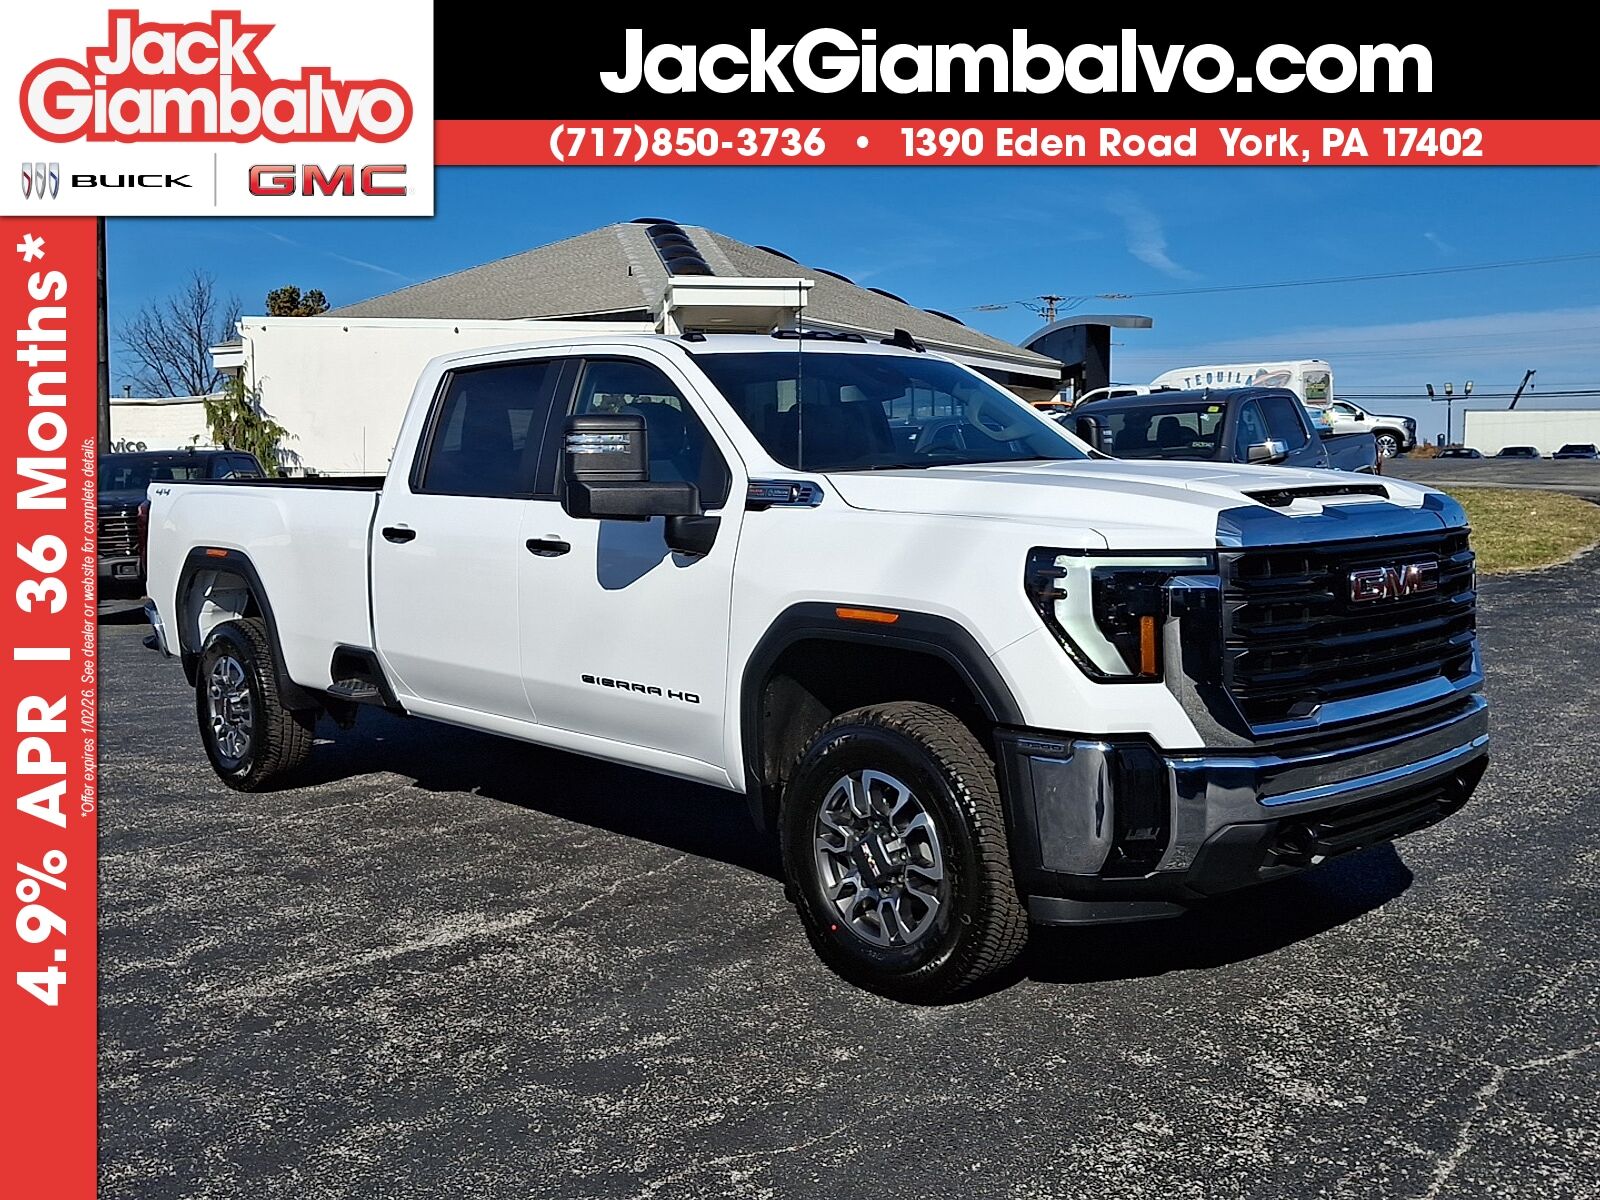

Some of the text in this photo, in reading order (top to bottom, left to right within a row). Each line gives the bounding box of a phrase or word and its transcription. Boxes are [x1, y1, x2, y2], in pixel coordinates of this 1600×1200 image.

[1350, 561, 1438, 602] GMC
[581, 674, 700, 703] SIERRA HD
